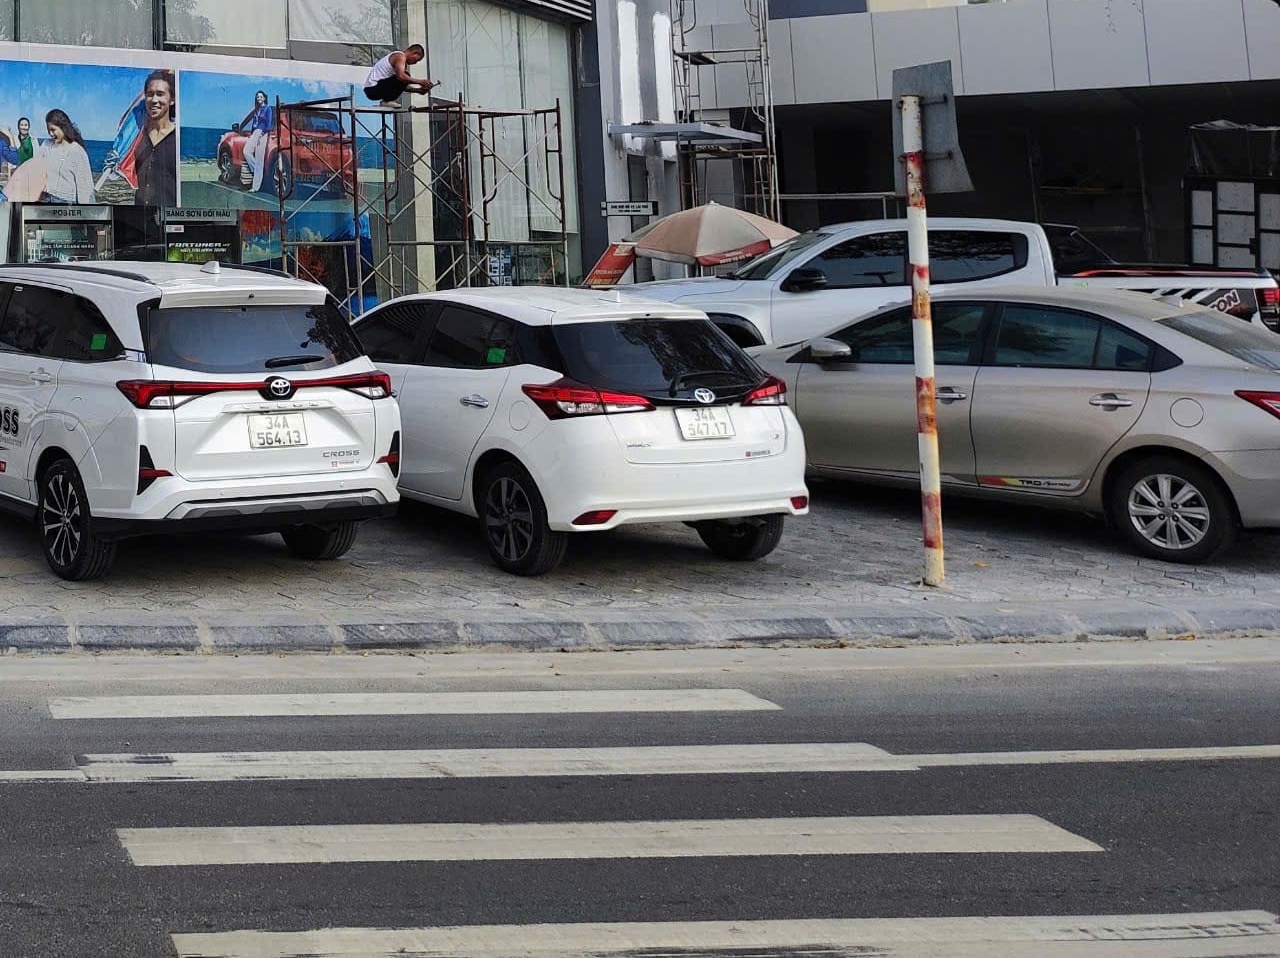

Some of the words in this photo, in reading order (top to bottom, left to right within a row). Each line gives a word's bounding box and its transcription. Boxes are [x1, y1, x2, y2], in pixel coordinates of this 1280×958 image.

[1209, 289, 1241, 313] ON
[264, 415, 290, 430] 34A
[692, 408, 716, 422] 34A
[257, 430, 302, 446] 564.13
[322, 449, 360, 458] CROSS
